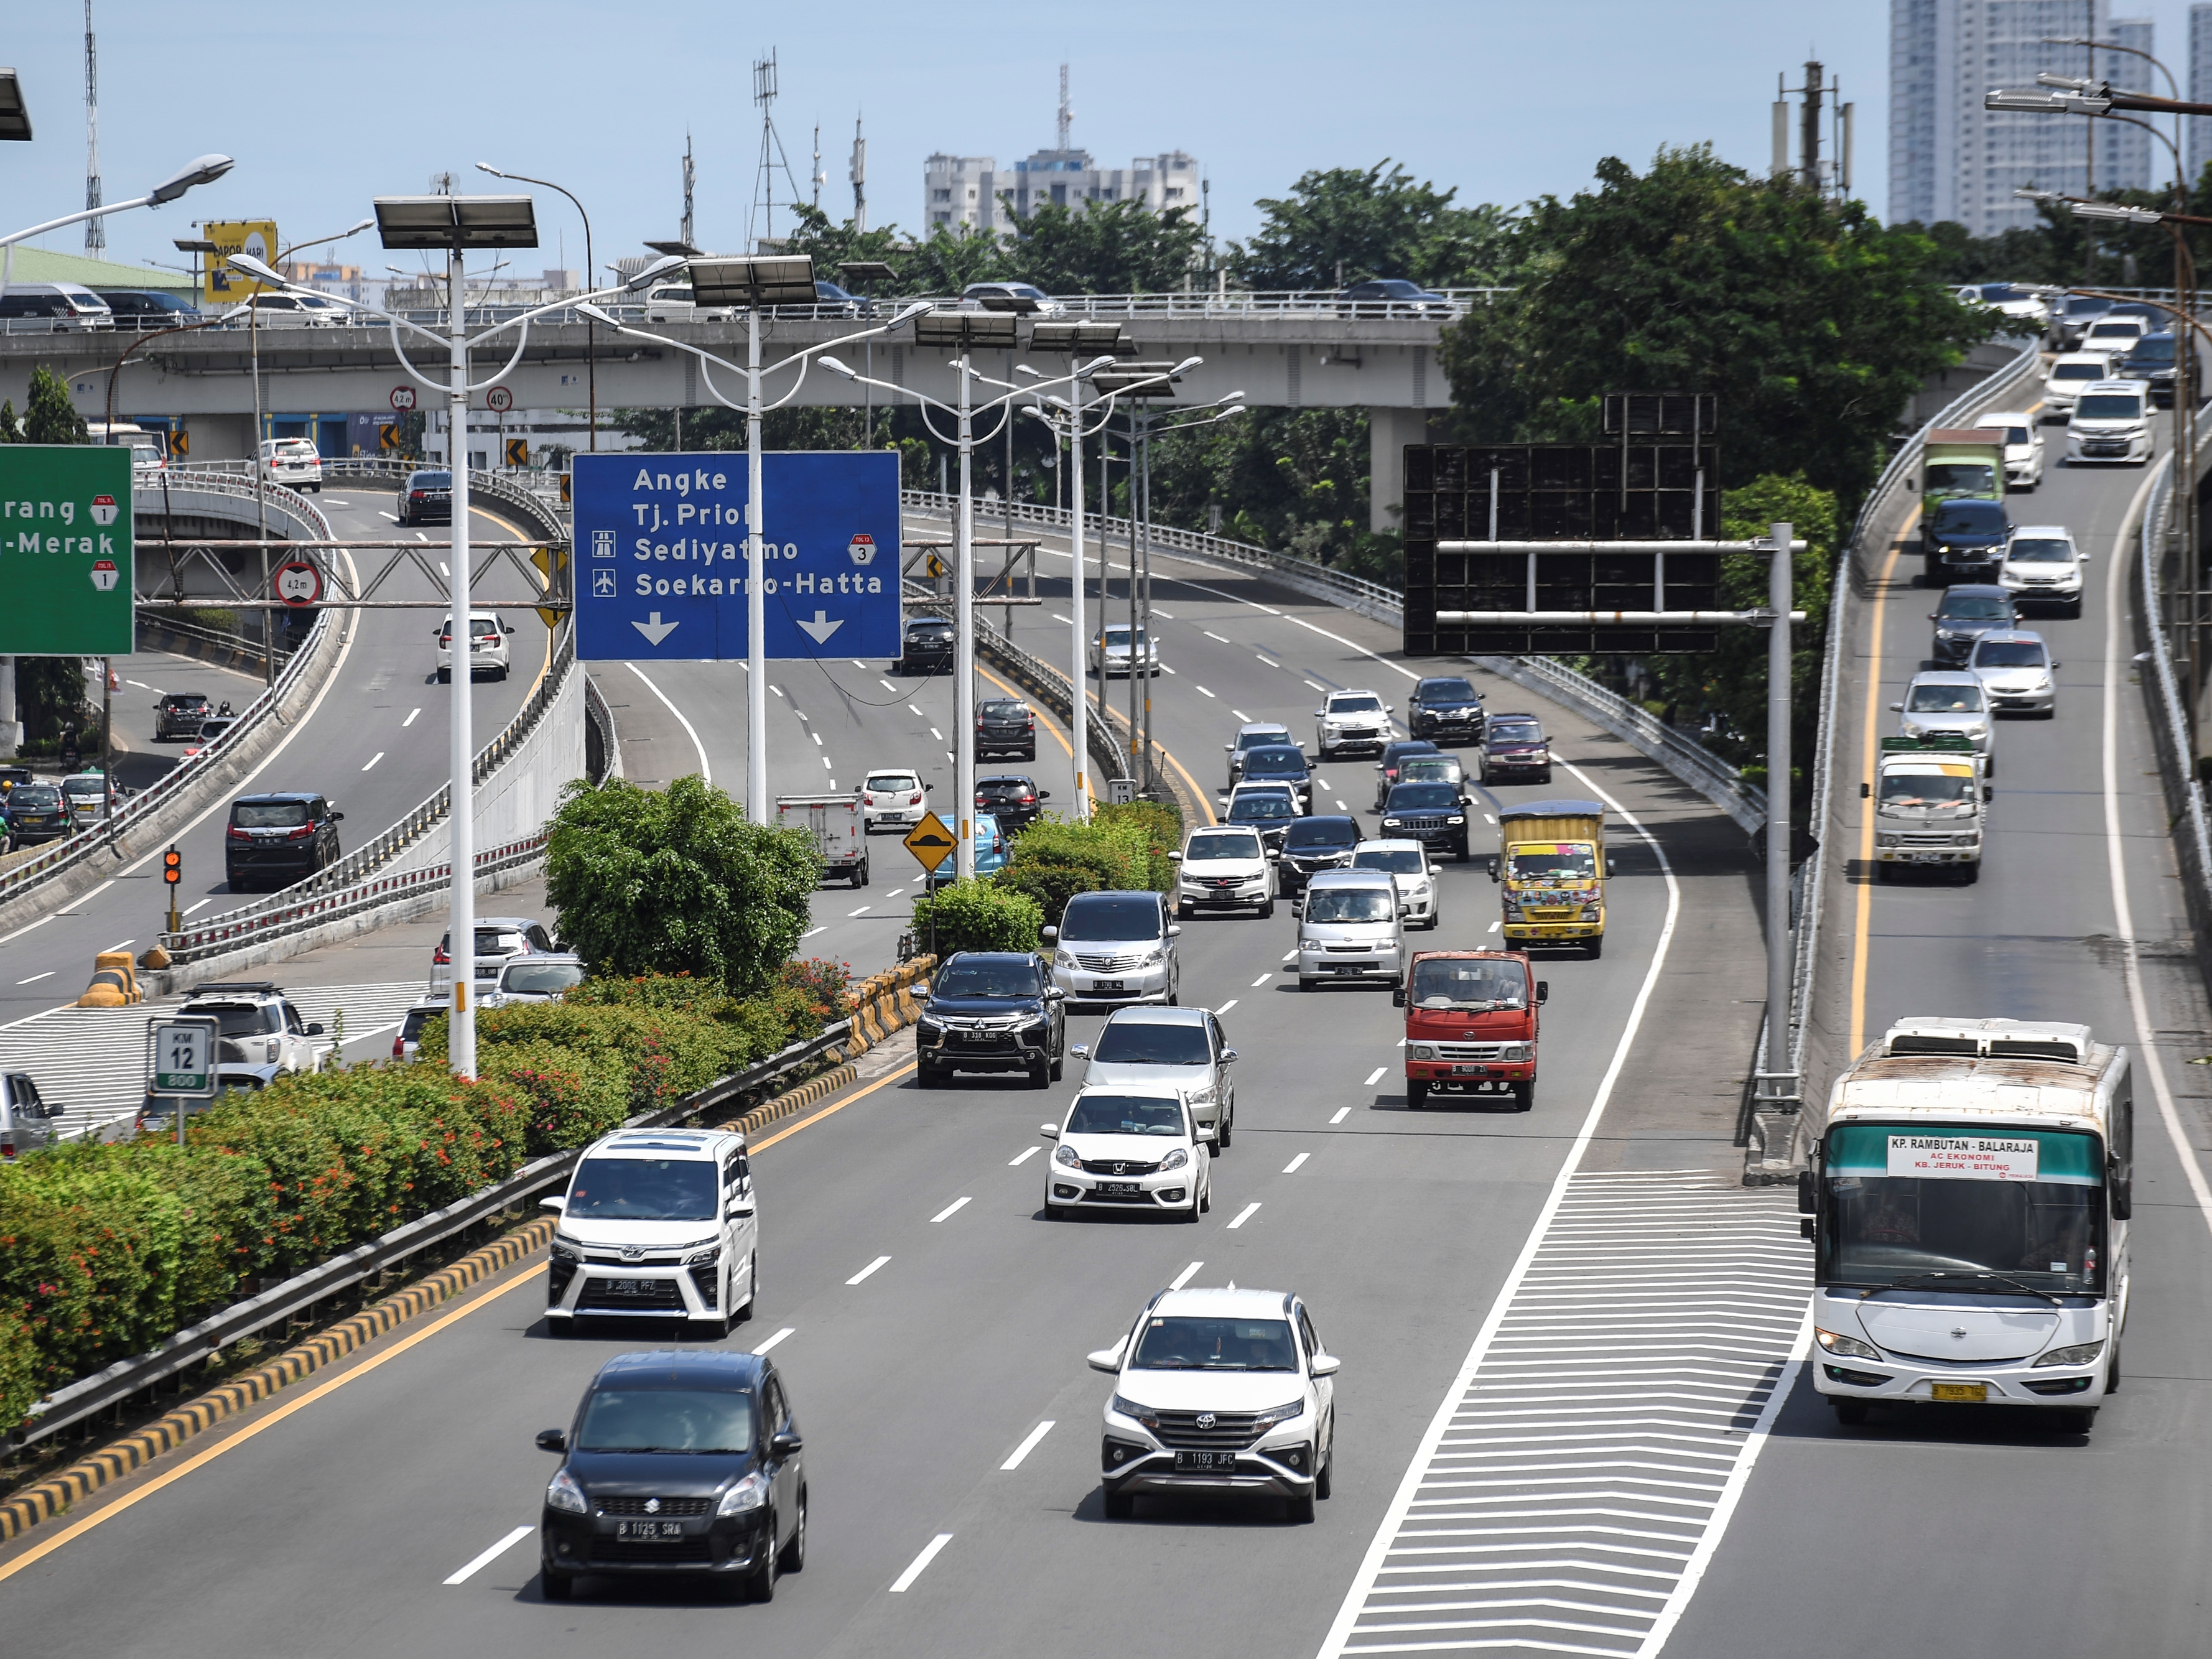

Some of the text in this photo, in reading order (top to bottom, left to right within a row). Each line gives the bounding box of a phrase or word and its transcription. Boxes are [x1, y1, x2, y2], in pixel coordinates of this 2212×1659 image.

[491, 394, 503, 406] 40
[633, 468, 727, 498] Angke
[4, 501, 74, 526] rang
[102, 508, 106, 521] 1
[633, 503, 669, 533] Tj.
[0, 532, 113, 554] -Merak
[858, 547, 867, 560] 3
[103, 574, 106, 587] 1
[1117, 795, 1130, 805] 13
[172, 1033, 193, 1044] KM
[170, 1047, 194, 1069] 12
[167, 1074, 197, 1087] 800
[1892, 1138, 1907, 1149] KP.
[1910, 1138, 1969, 1151] RAMBUTAN
[1979, 1141, 2034, 1153] BALARAJA
[1947, 1153, 1994, 1161] EKONOMI
[1099, 1183, 1103, 1191] B
[1108, 1184, 1123, 1192] 2526
[607, 1281, 611, 1290] B
[641, 1281, 654, 1290] PFZ
[1934, 1385, 1938, 1395] B
[1178, 1453, 1233, 1465] B 1193 JFC
[619, 1523, 680, 1535] B 1125 SRA
